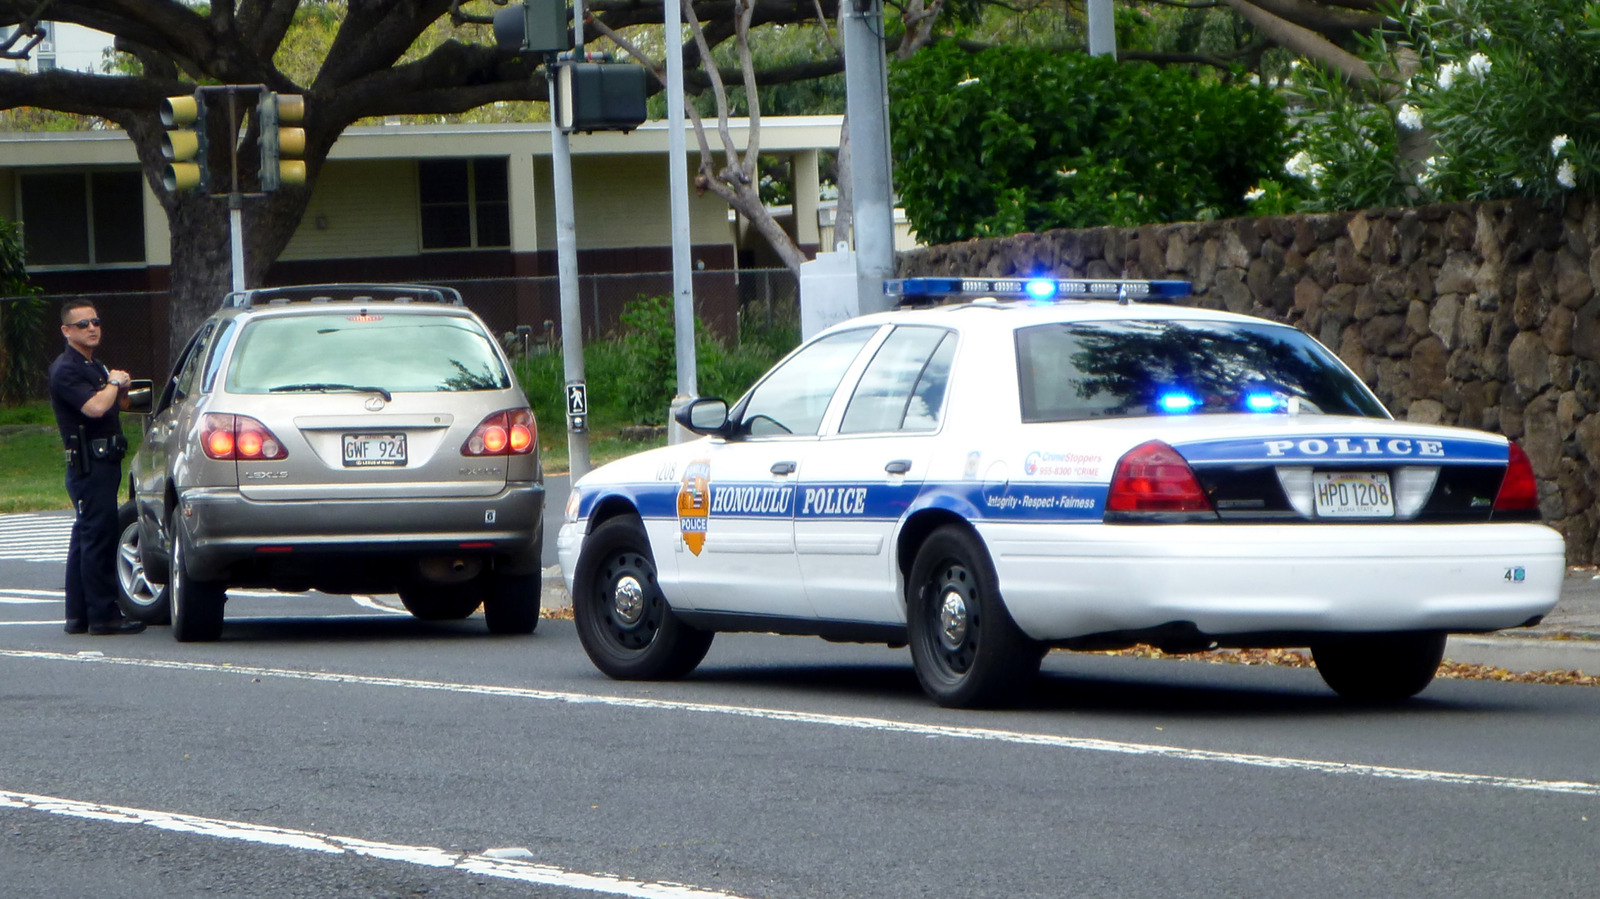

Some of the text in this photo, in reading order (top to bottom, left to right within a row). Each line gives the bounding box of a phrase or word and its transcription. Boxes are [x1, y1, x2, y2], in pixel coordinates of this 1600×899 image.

[345, 440, 404, 458] GWF 924
[1263, 438, 1445, 457] POLICE
[245, 471, 288, 479] LEXUS
[712, 486, 867, 514] HONOLULU POLICE
[987, 494, 1095, 510] Integrity Respect Fairness
[1318, 483, 1389, 506] HPD 1208
[681, 518, 706, 530] POLICE
[1504, 569, 1513, 581] 4
